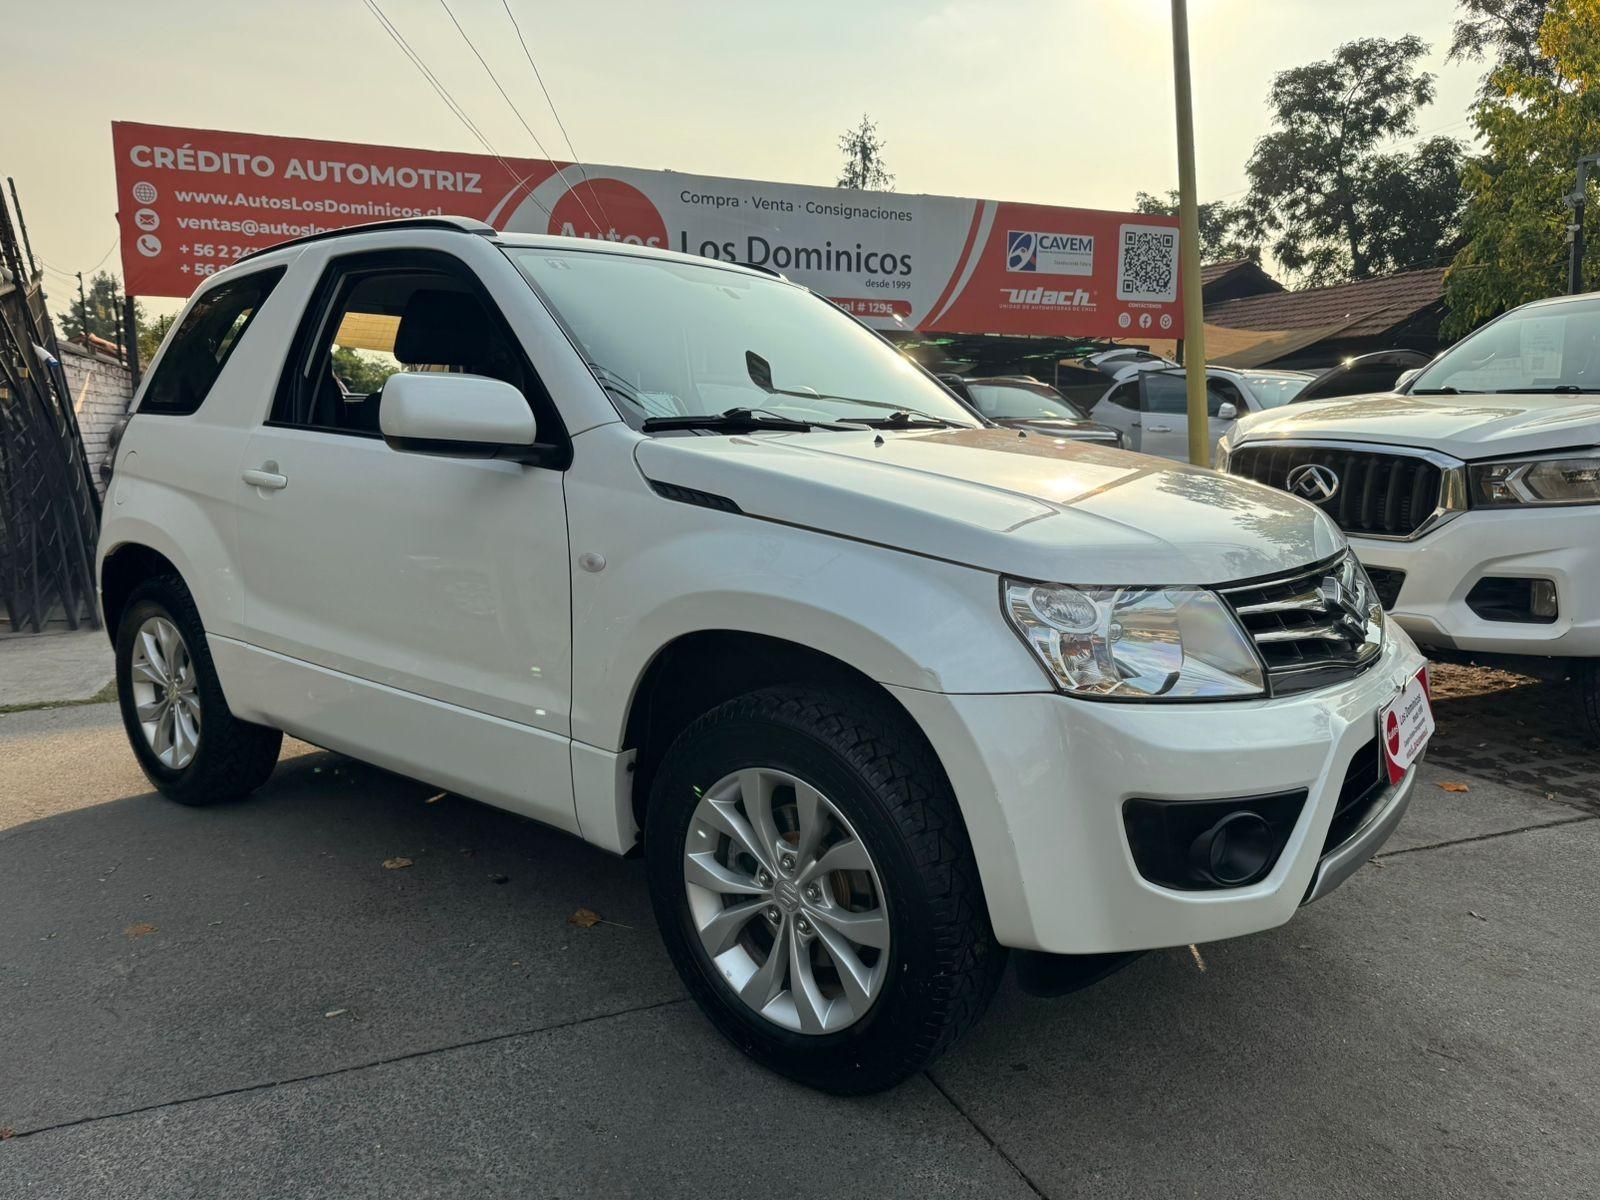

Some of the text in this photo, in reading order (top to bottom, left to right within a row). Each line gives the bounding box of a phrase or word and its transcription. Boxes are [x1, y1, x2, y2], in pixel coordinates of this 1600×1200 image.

[129, 143, 483, 194] CRÉDITO AUTOMOTRIZ
[174, 190, 442, 217] www.AutosLosDominicos.cl
[680, 190, 740, 208] Compra
[752, 196, 793, 212] Venta
[805, 201, 913, 222] Consignaciones
[193, 243, 215, 257] 56
[217, 244, 229, 258] 2
[1038, 235, 1092, 251] CAVEM
[747, 236, 913, 275] Dominicos
[194, 263, 216, 276] 56
[865, 279, 911, 289] desde 1999
[1000, 287, 1097, 306] udach
[857, 302, 865, 313] #
[868, 302, 893, 313] 1295
